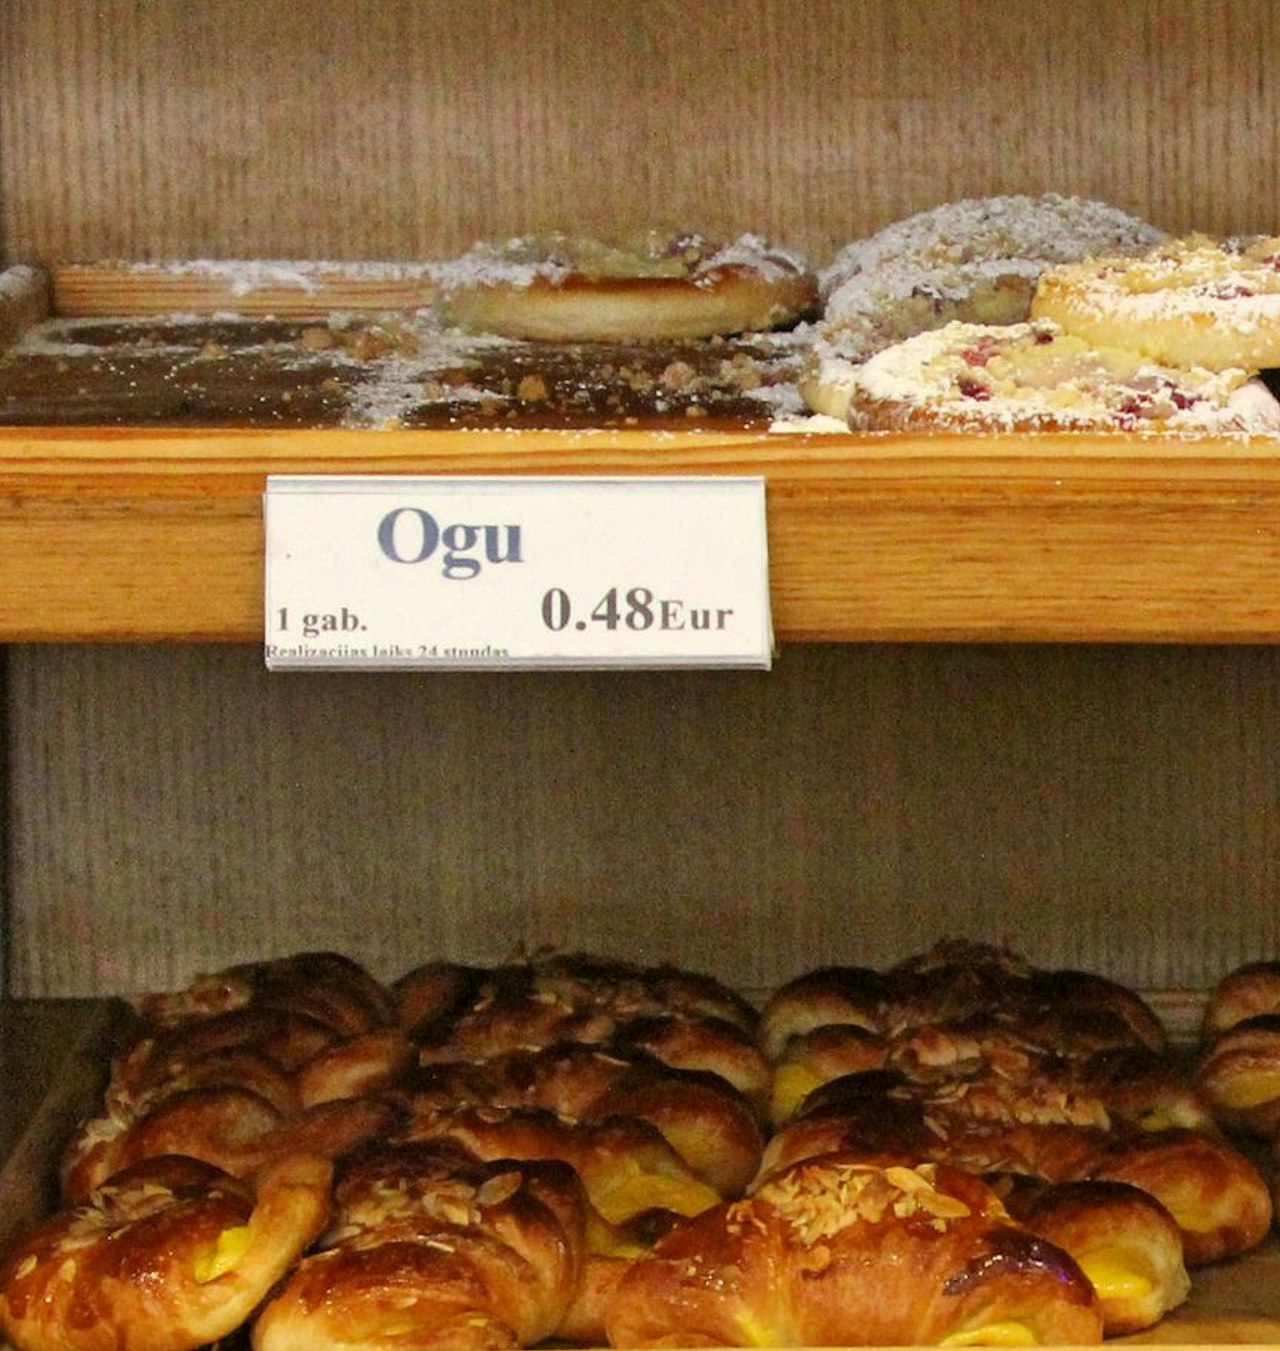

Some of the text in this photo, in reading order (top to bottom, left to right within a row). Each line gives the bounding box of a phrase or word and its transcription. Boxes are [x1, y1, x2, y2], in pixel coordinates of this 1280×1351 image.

[377, 506, 524, 580] Ogu
[276, 607, 368, 636] 1 gab.
